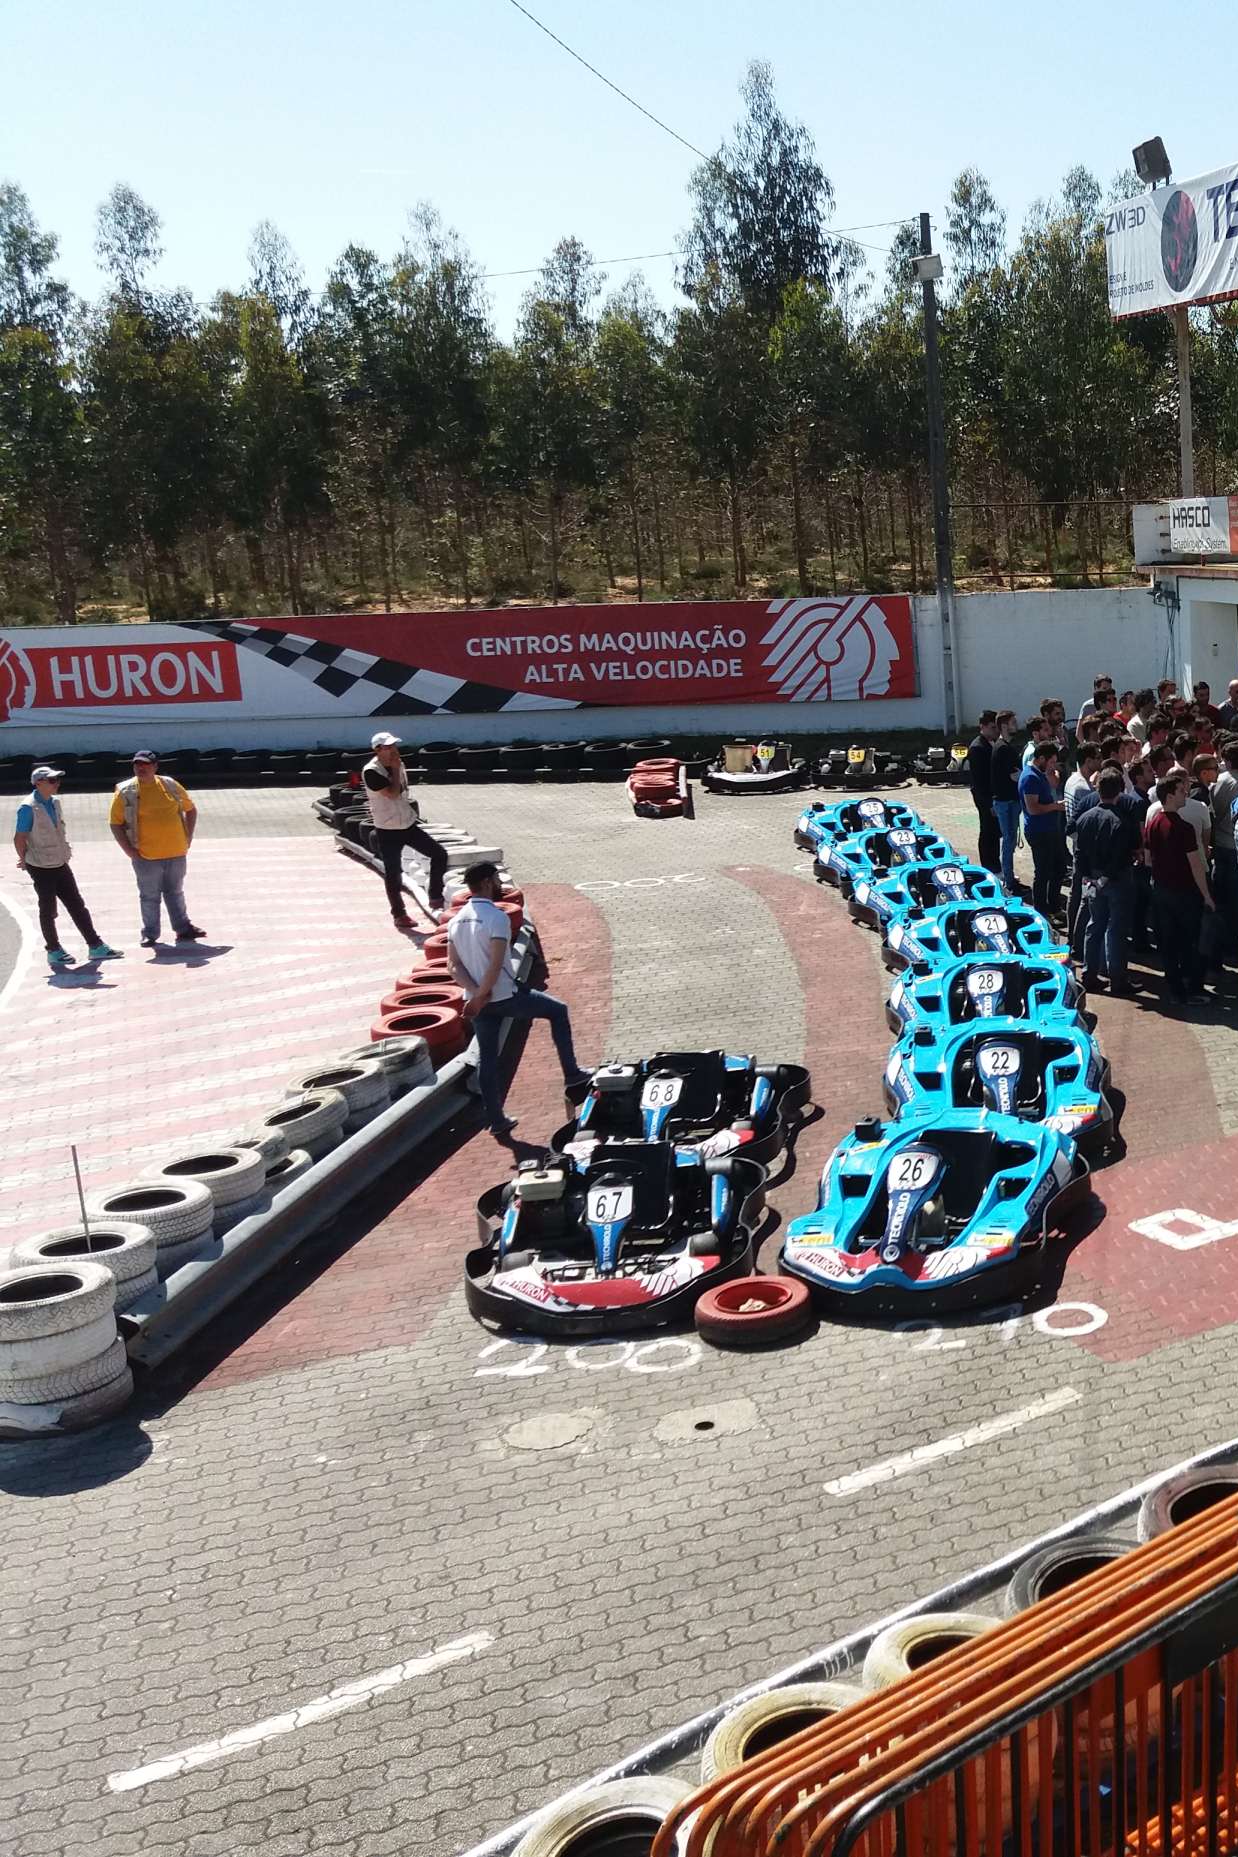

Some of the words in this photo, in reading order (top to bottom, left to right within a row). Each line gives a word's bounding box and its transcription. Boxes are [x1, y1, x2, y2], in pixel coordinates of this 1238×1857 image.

[1173, 506, 1210, 528] HASCO
[466, 634, 573, 657] CENTROS
[579, 625, 747, 653] MAQUINAÇÃO
[50, 650, 225, 700] HURON
[524, 662, 585, 683] ALTA
[589, 658, 744, 681] VELOCIDADE
[897, 831, 910, 842] 23
[943, 870, 957, 881] 27
[985, 918, 1000, 931] 21
[978, 973, 994, 989] 28
[991, 1051, 1009, 1070] 22
[650, 1084, 674, 1102] 68
[898, 1158, 925, 1181] 26
[595, 1191, 622, 1219] 67
[805, 1252, 844, 1278] HURON
[511, 1280, 549, 1302] HURON
